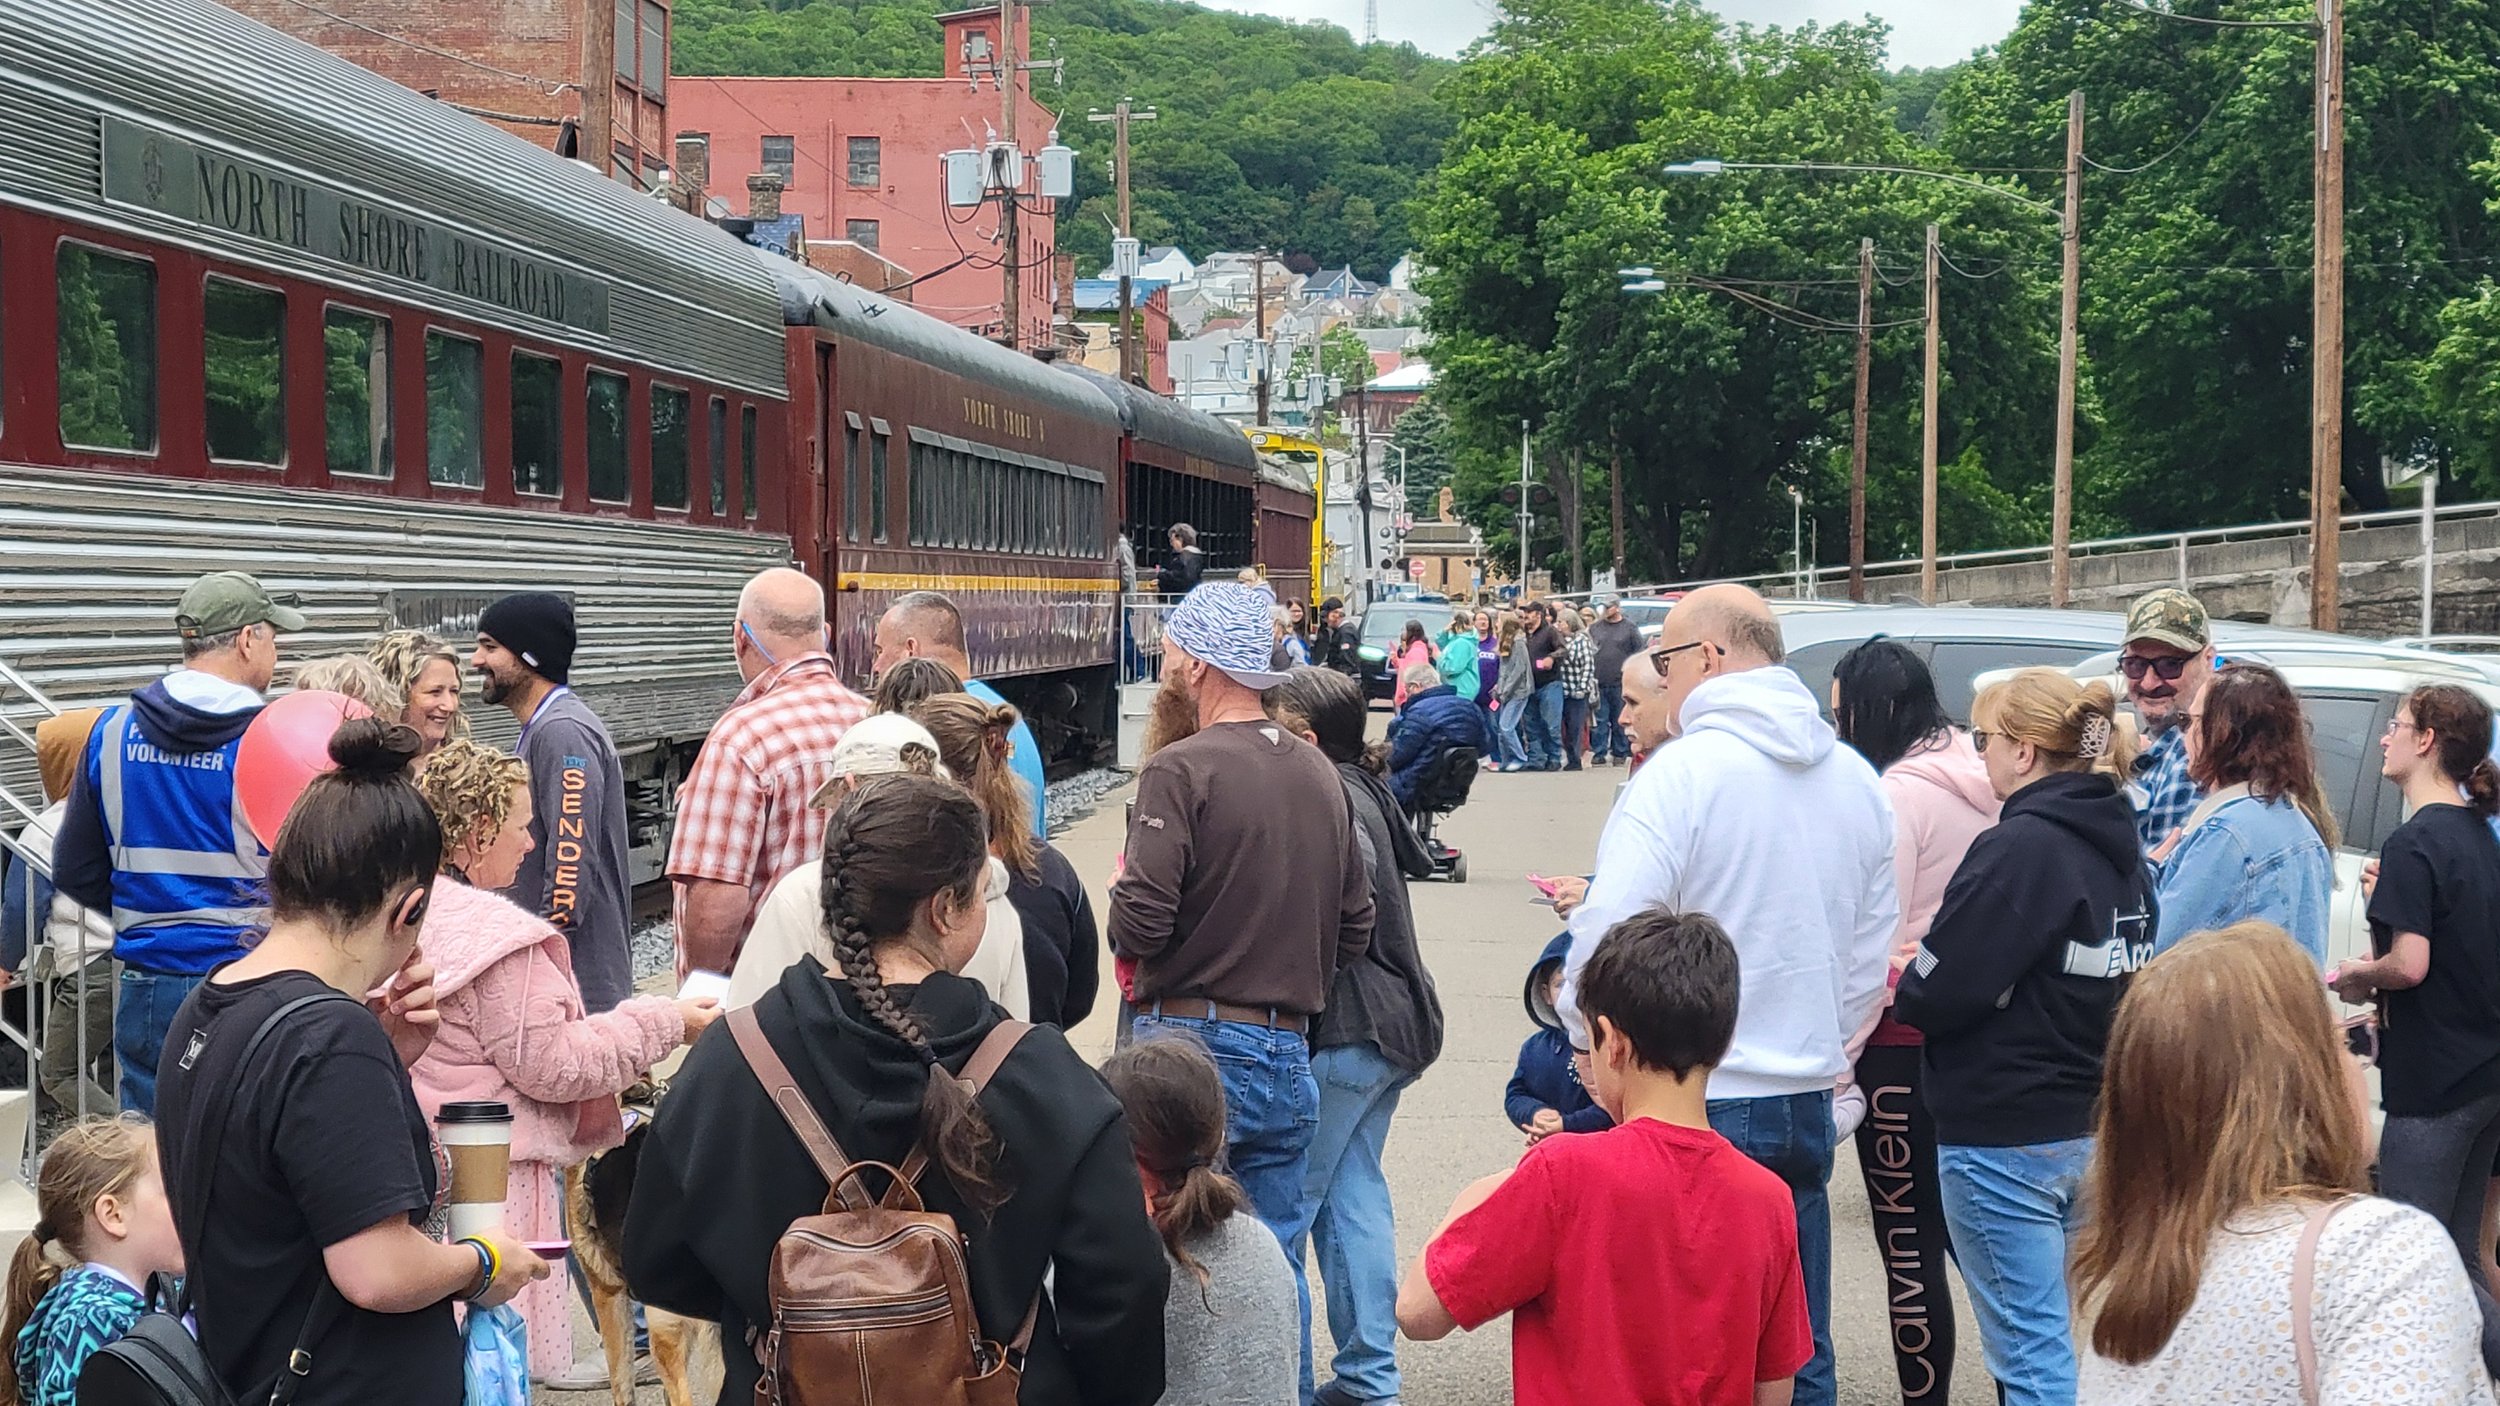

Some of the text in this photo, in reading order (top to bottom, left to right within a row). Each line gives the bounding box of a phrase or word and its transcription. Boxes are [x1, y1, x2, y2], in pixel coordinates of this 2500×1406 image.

[196, 154, 566, 322] NORTH SHORE RAILROAD
[963, 397, 996, 430] NORTH
[1003, 409, 1032, 439] SHORE
[126, 743, 224, 772] VOLUNTEER
[1866, 1085, 1936, 1399] Calvin Klein
